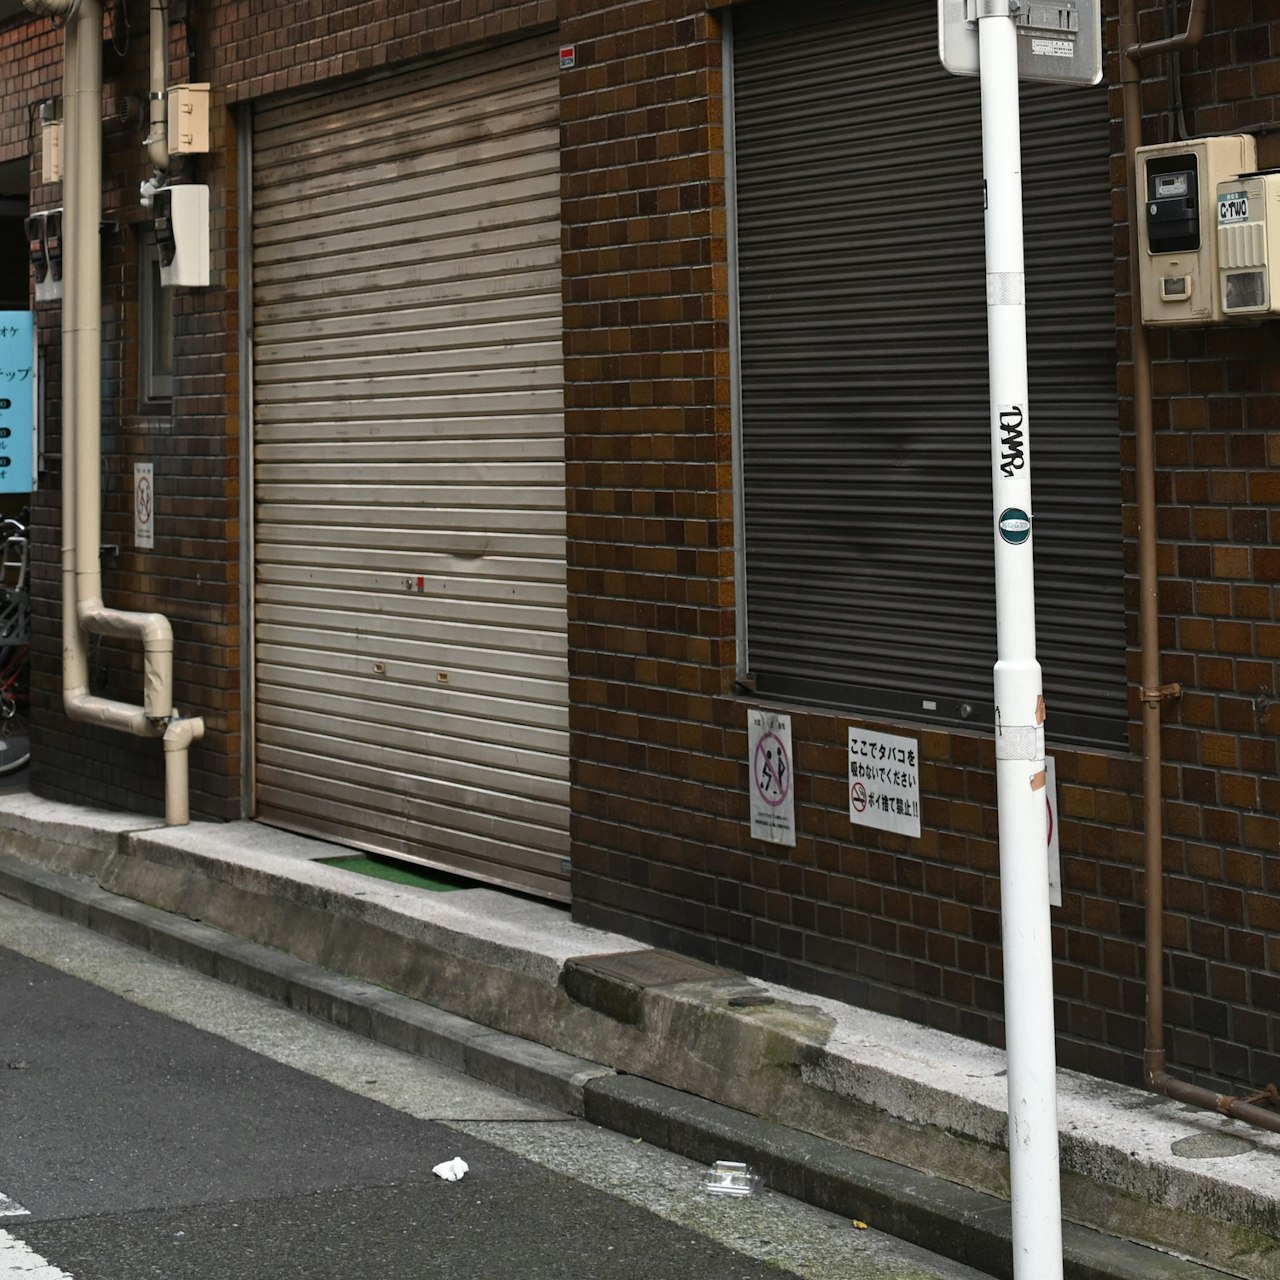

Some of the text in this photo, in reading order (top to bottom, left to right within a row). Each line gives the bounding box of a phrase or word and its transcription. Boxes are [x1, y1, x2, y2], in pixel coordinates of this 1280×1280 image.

[851, 738, 915, 767] ここでタバコを
[851, 761, 916, 788] 吸わないでください
